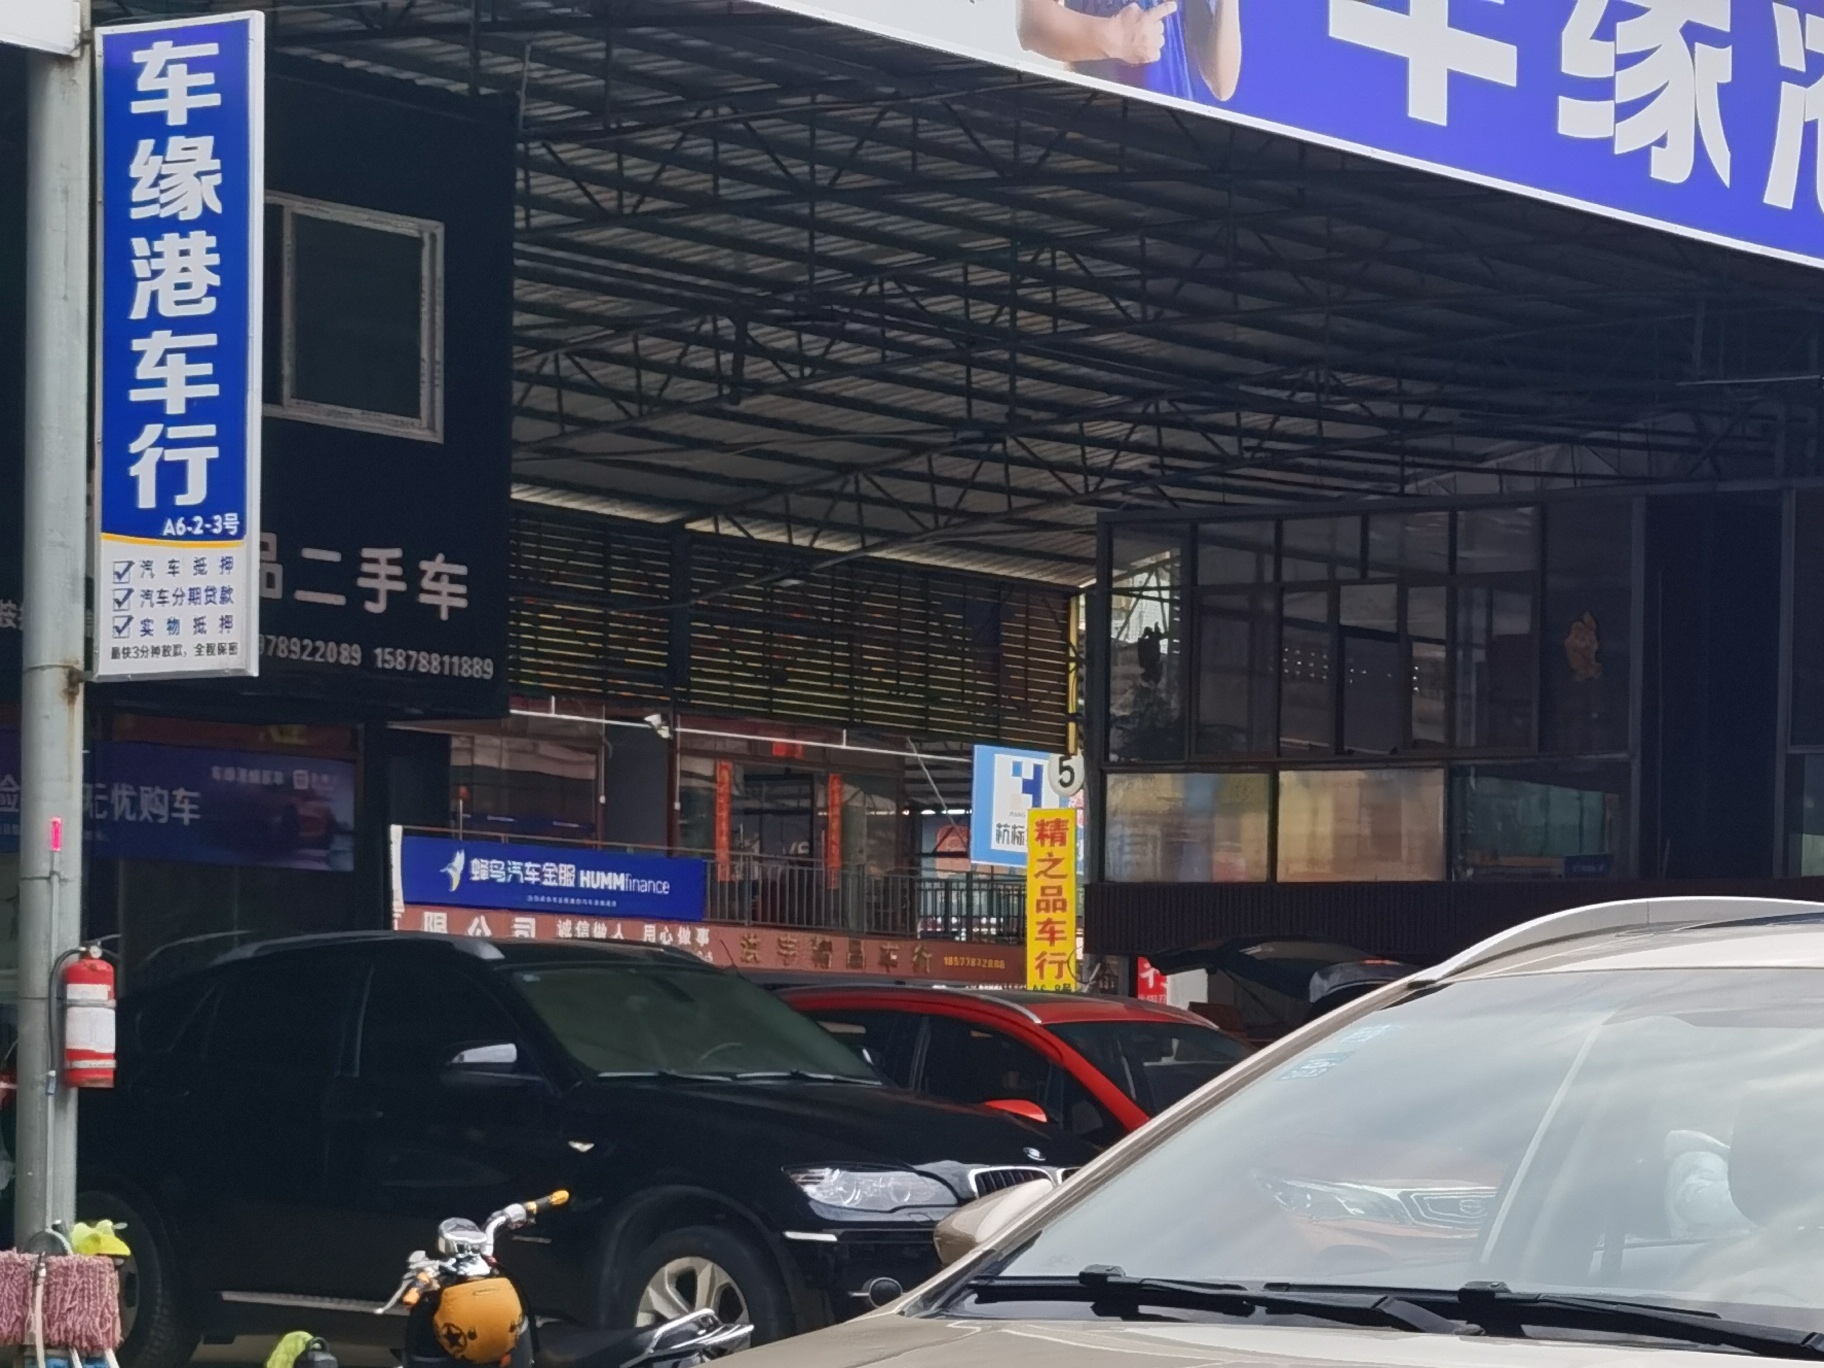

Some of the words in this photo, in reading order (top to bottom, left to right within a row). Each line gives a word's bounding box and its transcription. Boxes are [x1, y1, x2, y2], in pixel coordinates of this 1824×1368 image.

[129, 40, 221, 508] 车缘港车行
[163, 513, 241, 537] A6-2-3号
[140, 585, 235, 608] 汽车分期贷款
[373, 647, 494, 680] 15878811889
[1058, 755, 1076, 789] 5
[579, 869, 671, 895] HUMMfinance
[1034, 817, 1070, 981] 精之品车行
